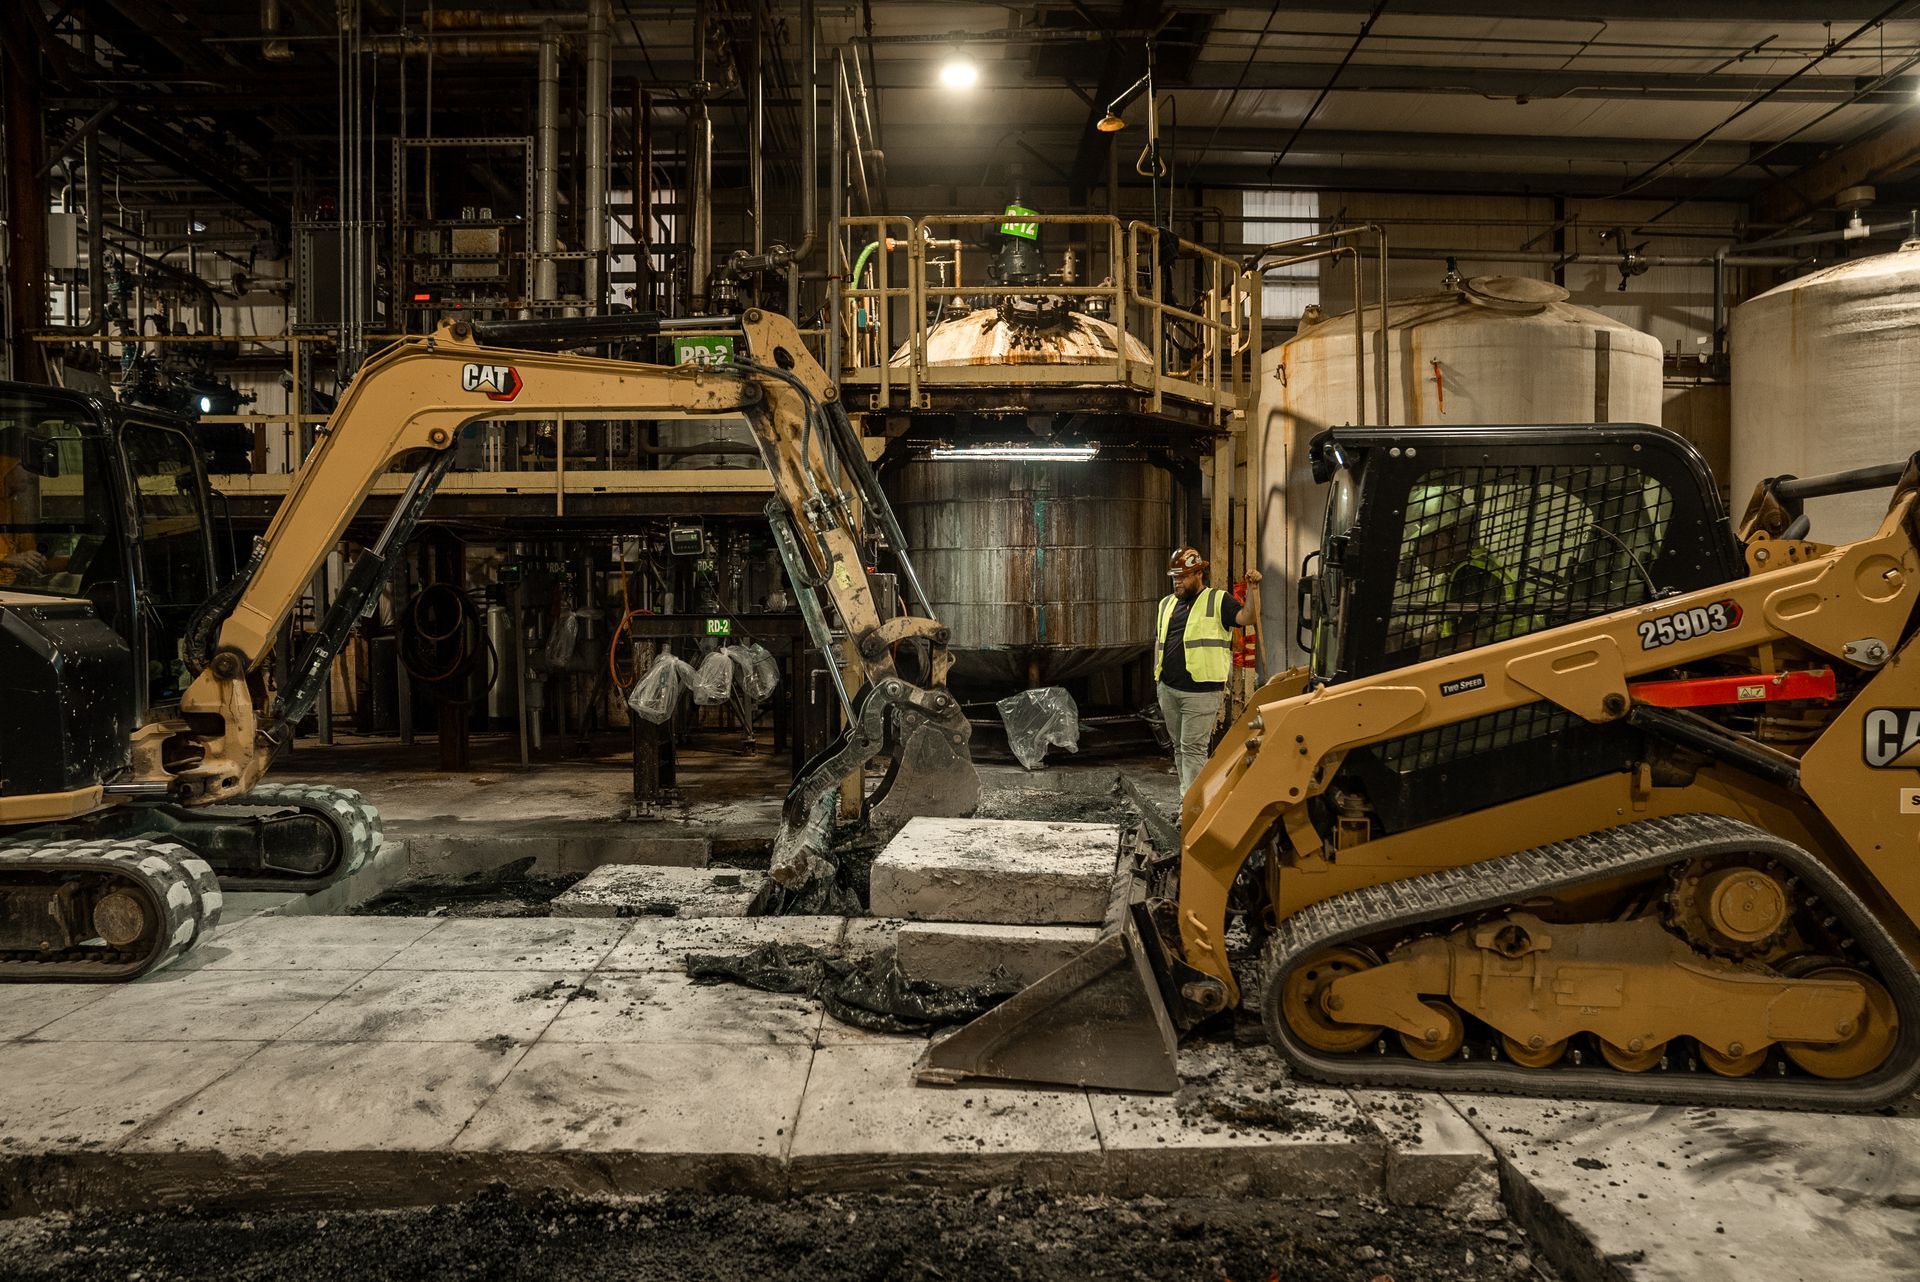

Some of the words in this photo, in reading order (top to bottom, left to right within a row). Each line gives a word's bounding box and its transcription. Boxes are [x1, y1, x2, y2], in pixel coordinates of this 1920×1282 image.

[463, 363, 509, 393] CAT
[697, 560, 714, 571] RD-5
[708, 619, 729, 633] RD-2
[1638, 603, 1727, 649] 259D3
